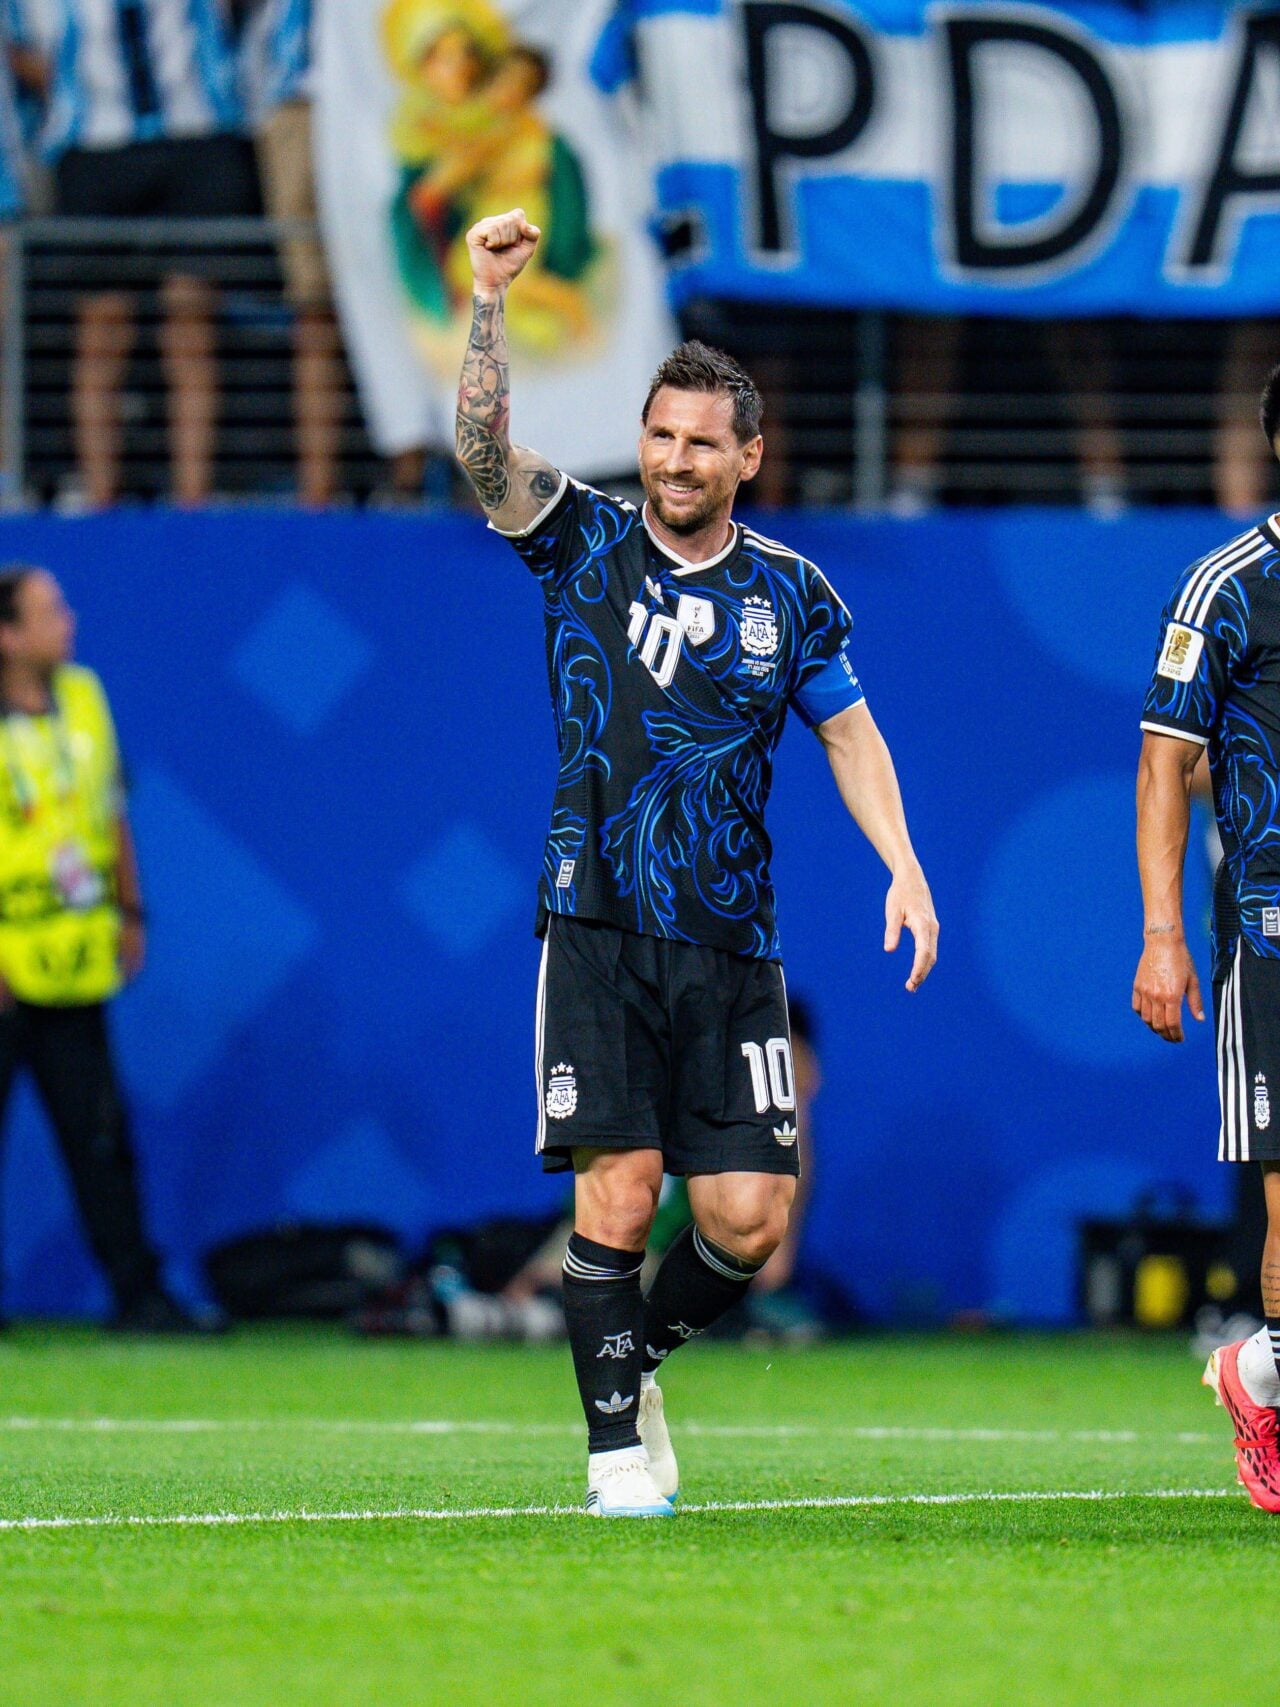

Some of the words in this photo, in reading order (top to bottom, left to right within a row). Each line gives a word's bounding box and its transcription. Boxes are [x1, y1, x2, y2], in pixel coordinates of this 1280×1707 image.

[687, 625, 704, 633] FIFA
[749, 620, 770, 642] AFA
[626, 600, 685, 689] 10
[741, 1037, 795, 1114] 10
[552, 1087, 571, 1106] AFA
[596, 1330, 635, 1359] AFA
